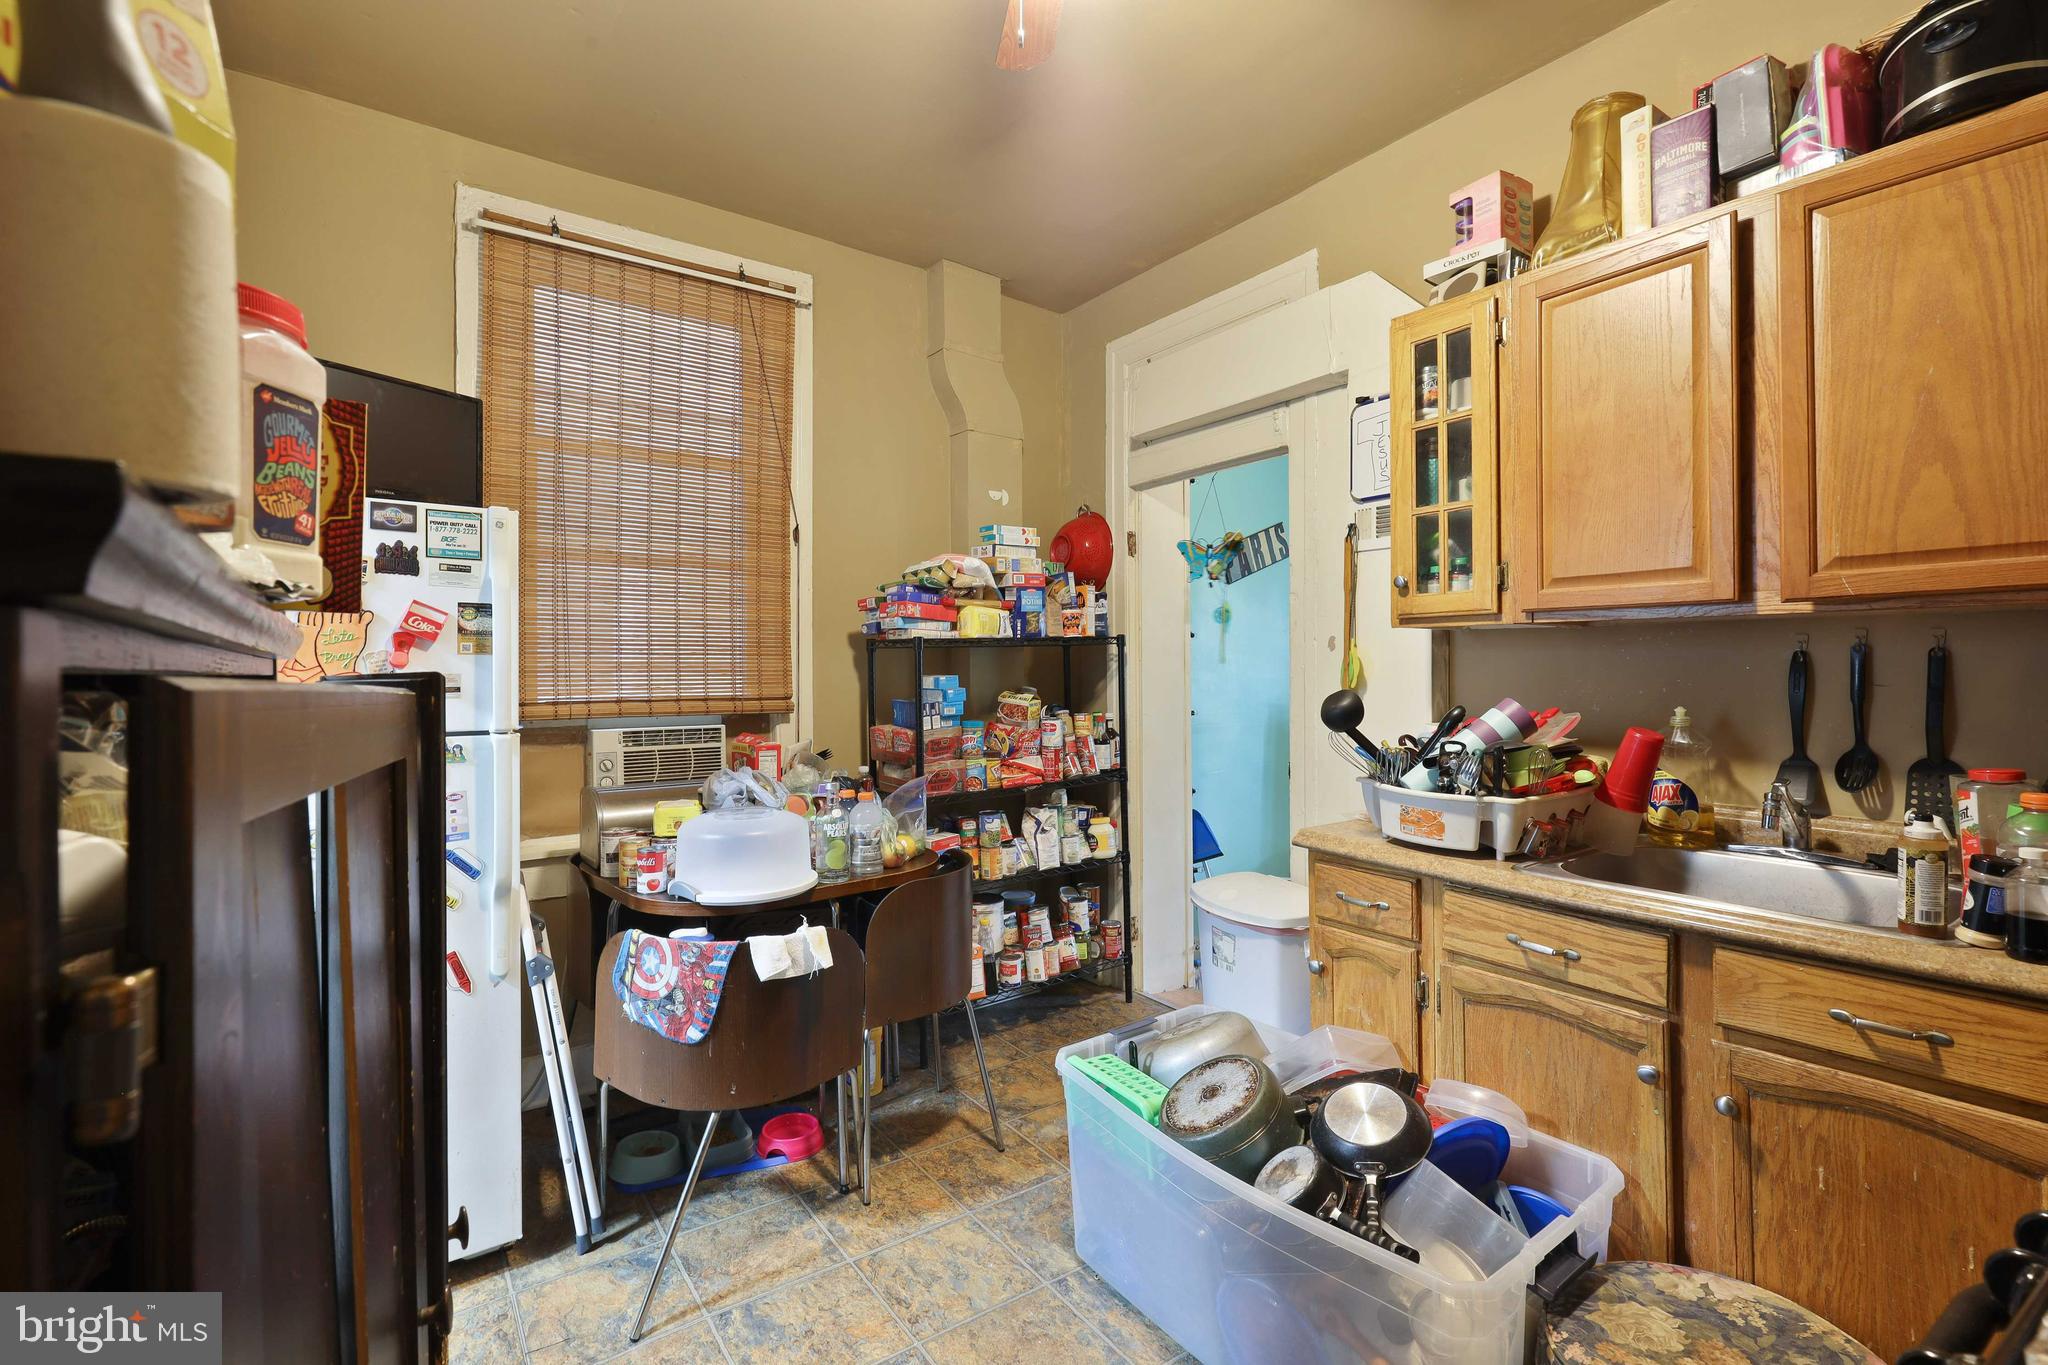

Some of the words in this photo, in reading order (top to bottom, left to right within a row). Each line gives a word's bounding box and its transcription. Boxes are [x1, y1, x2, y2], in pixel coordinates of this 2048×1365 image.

[1654, 141, 1708, 170] BALTIMORE
[1665, 151, 1697, 169] FOOTBALL
[263, 411, 316, 456] GOURMET
[265, 435, 317, 471] JELLY
[255, 461, 316, 490] BEANS
[297, 513, 313, 530] 41
[429, 525, 478, 536] 1-877-778-2222
[440, 535, 458, 543] BGE
[1225, 521, 1289, 585] ARIS
[407, 615, 436, 633] Coke
[1650, 783, 1682, 806] AJAX
